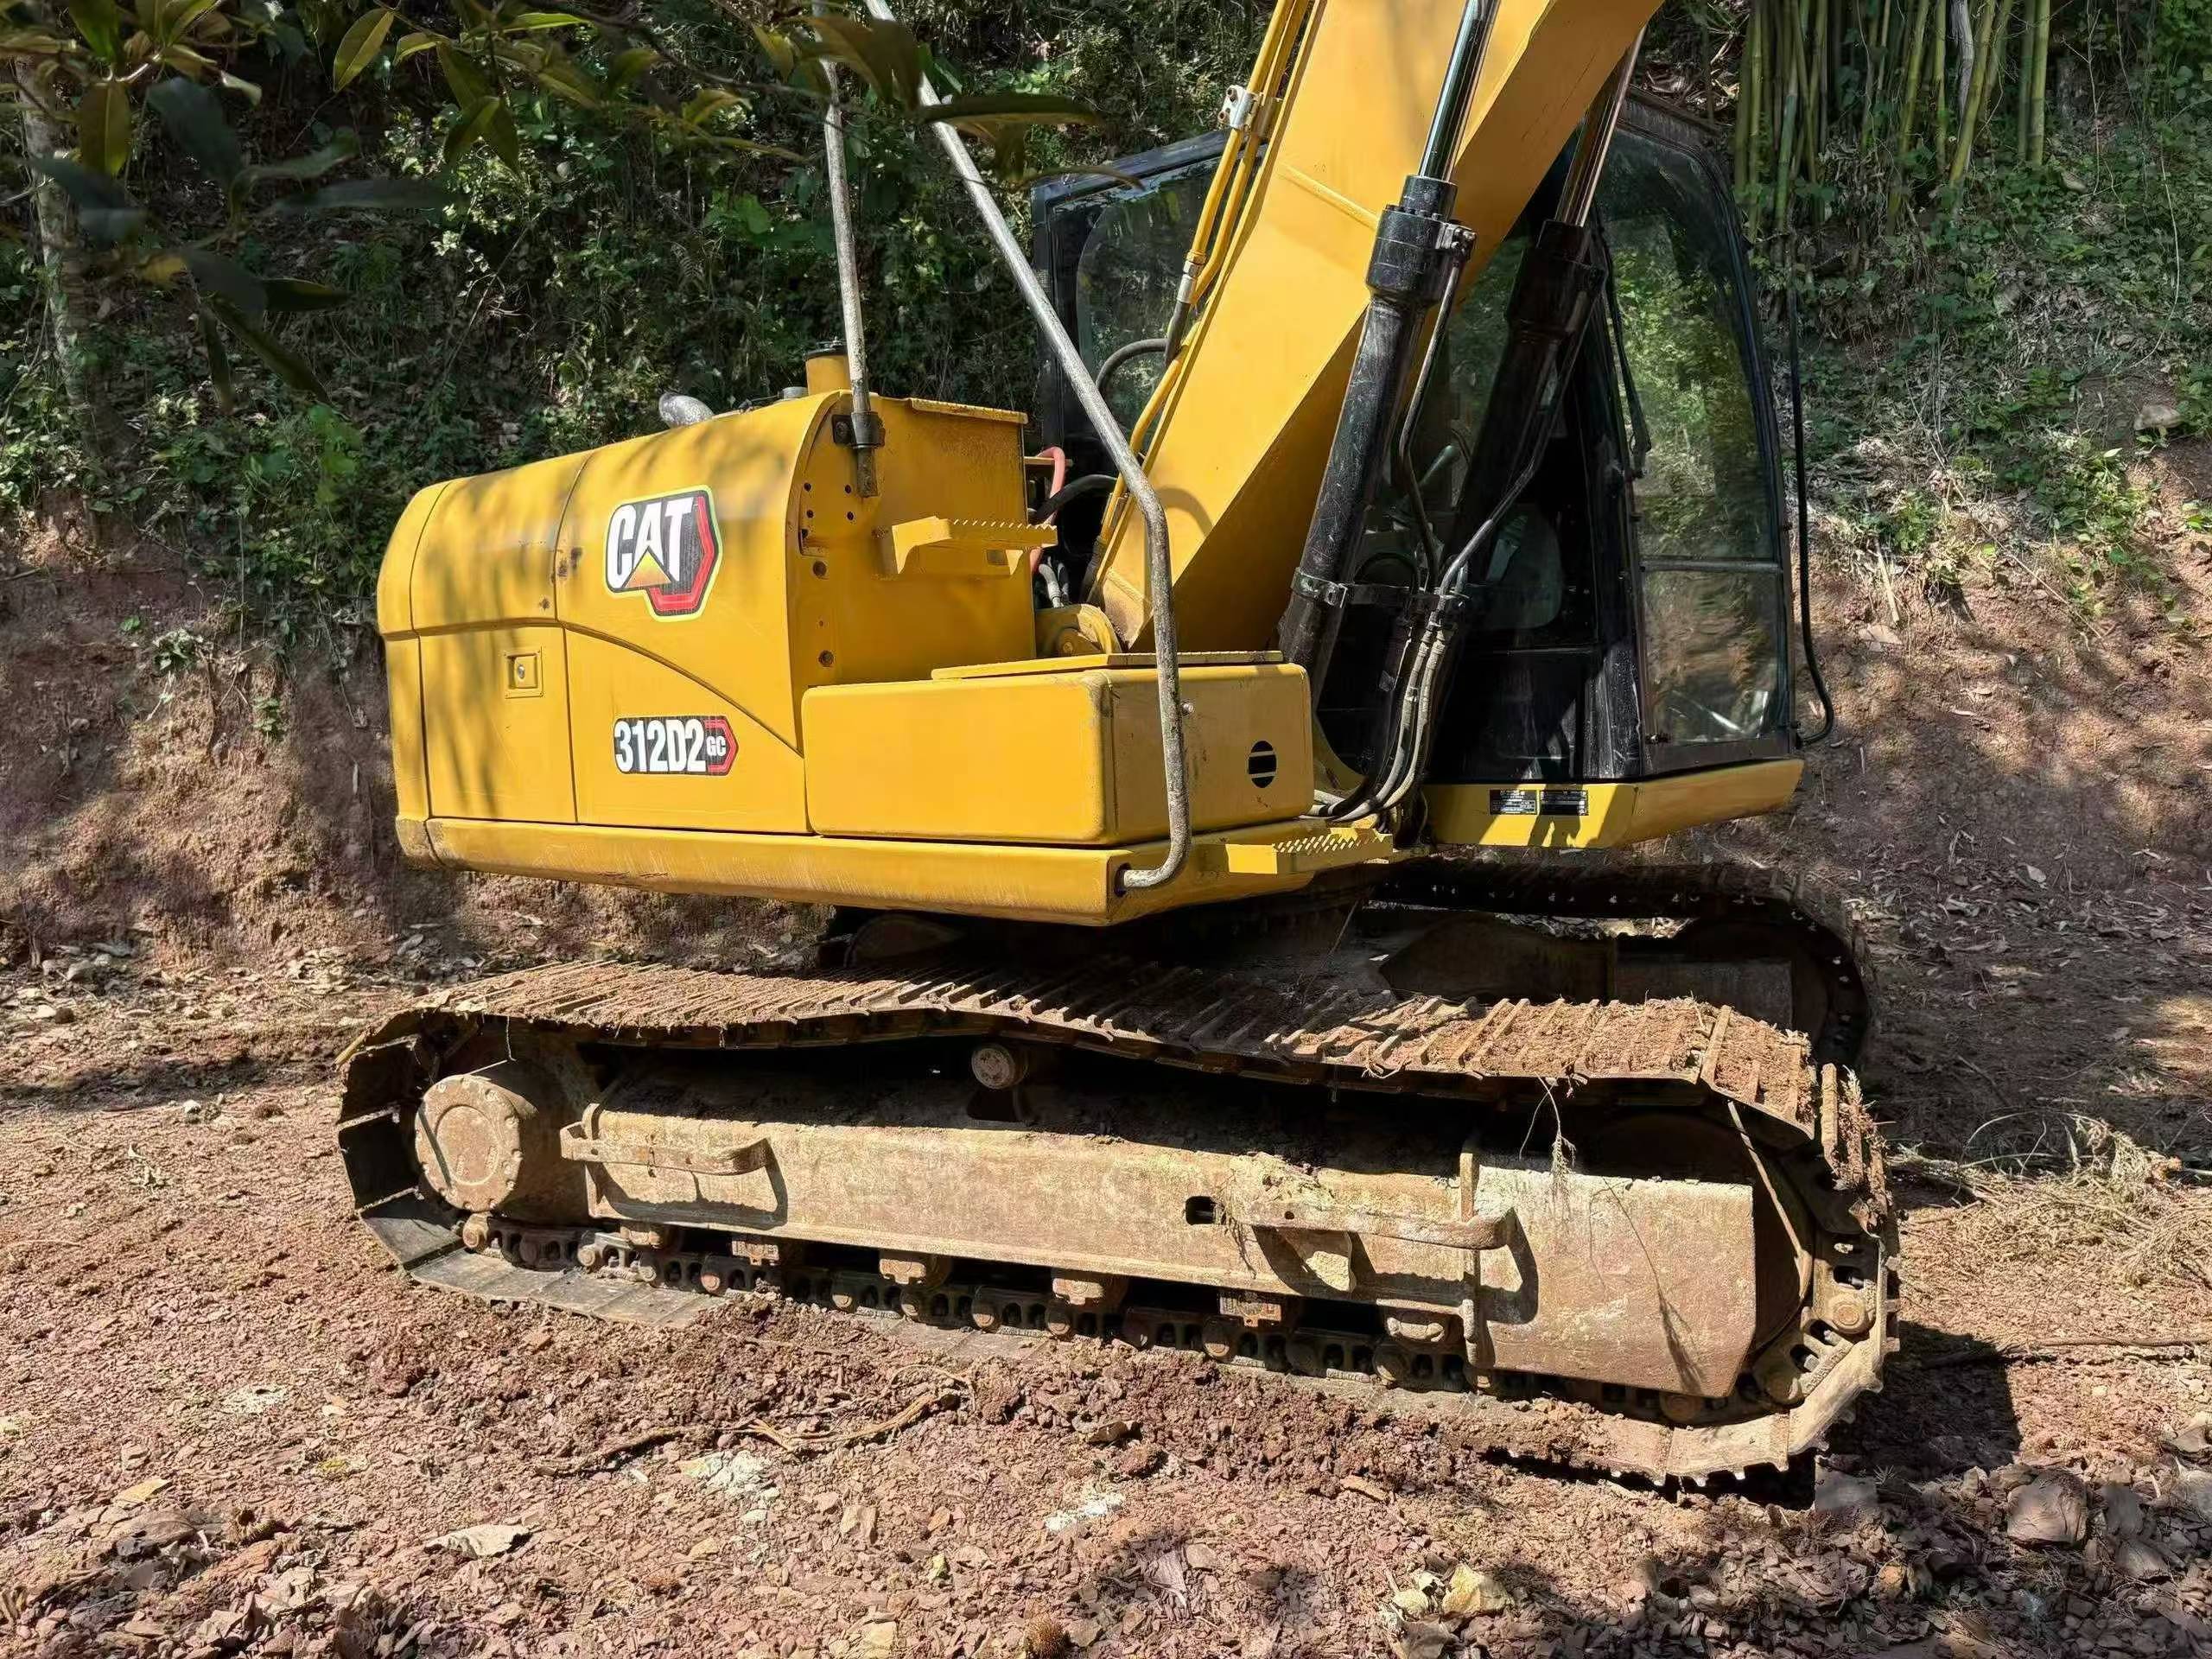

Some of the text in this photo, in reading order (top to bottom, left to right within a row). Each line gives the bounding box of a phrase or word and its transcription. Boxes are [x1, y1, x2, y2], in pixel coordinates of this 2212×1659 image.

[607, 497, 694, 588] CAT
[614, 718, 727, 772] 312D2 GC
